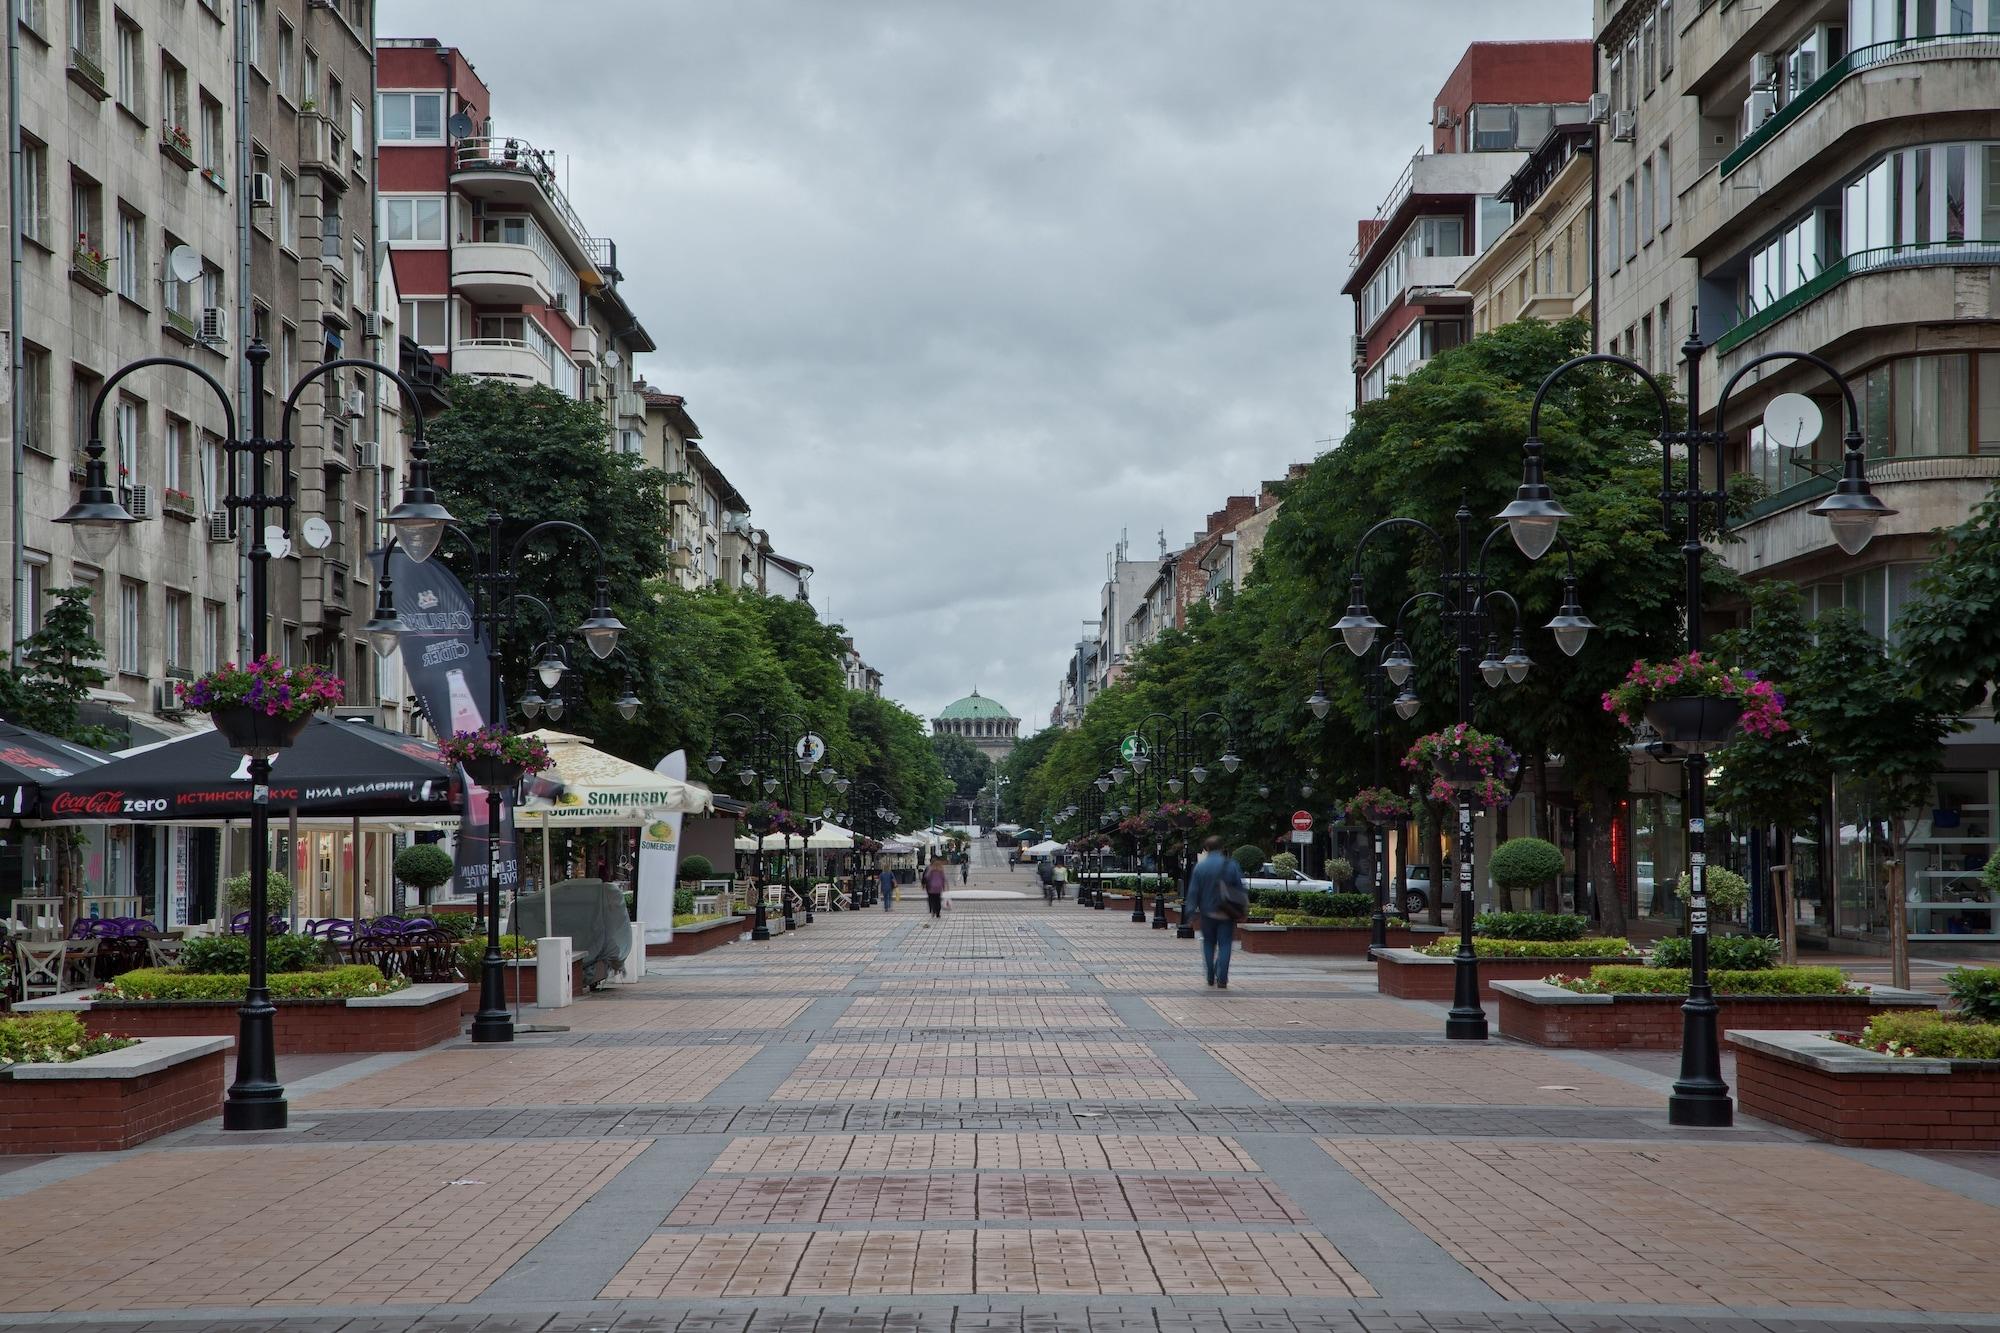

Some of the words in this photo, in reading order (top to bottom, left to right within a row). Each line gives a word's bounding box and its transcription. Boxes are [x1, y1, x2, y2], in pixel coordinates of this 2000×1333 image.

[268, 788, 299, 800] КУС
[305, 787, 343, 800] НУЛА
[123, 798, 168, 813] zero
[641, 840, 677, 852] SOMERSBY
